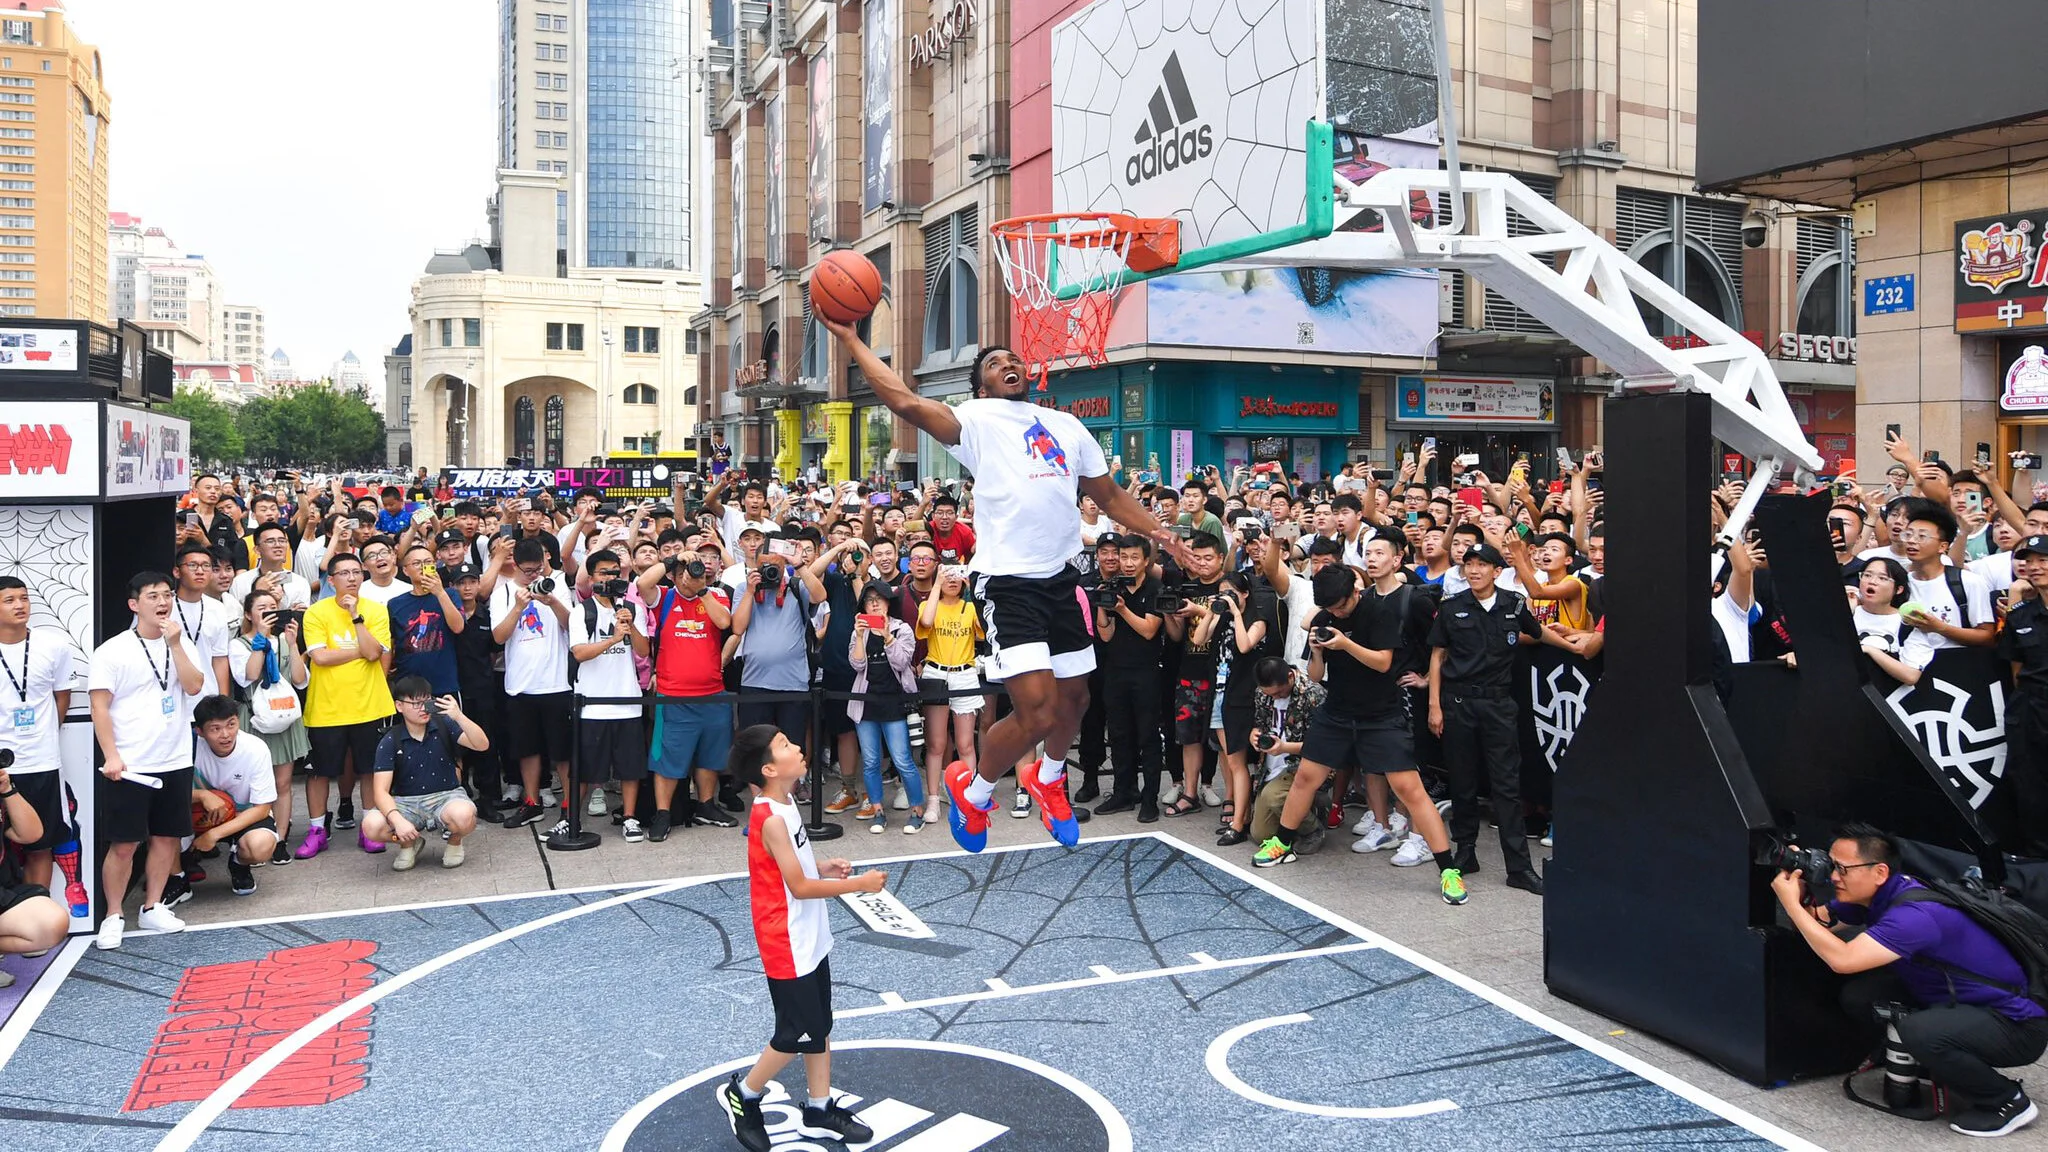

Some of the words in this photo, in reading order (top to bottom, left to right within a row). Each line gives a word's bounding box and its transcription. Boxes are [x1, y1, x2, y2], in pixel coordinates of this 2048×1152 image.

[1125, 123, 1214, 187] adidas
[1876, 286, 1904, 306] 232
[1072, 397, 1109, 417] MODERN
[2009, 397, 2037, 405] CHURIN
[555, 469, 624, 487] PLAZA
